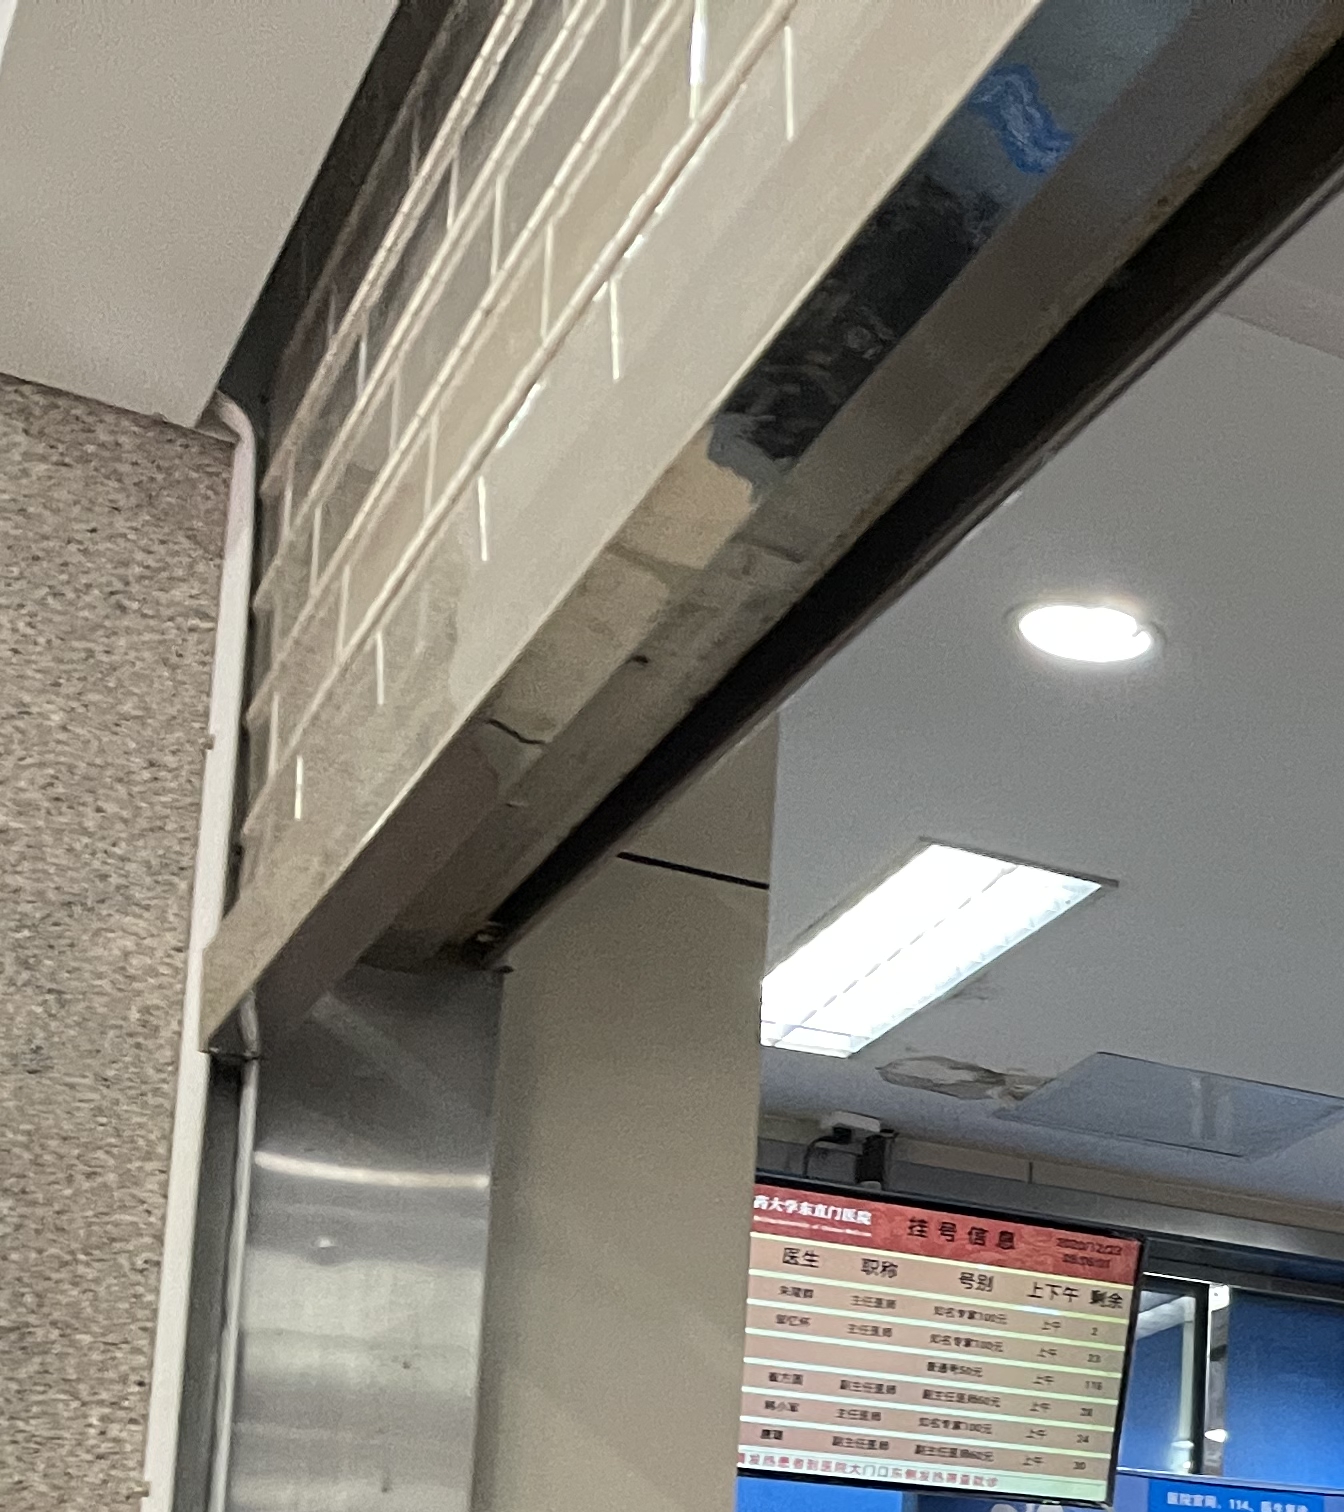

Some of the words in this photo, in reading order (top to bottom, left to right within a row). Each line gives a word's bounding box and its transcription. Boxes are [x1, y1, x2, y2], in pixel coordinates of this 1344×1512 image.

[907, 1215, 1015, 1250] 挂号信息
[782, 1247, 820, 1269] 医生
[860, 1258, 898, 1278] 职称
[958, 1271, 995, 1293] 号别
[1026, 1281, 1080, 1303] 上下午
[1089, 1290, 1124, 1309] 剩余
